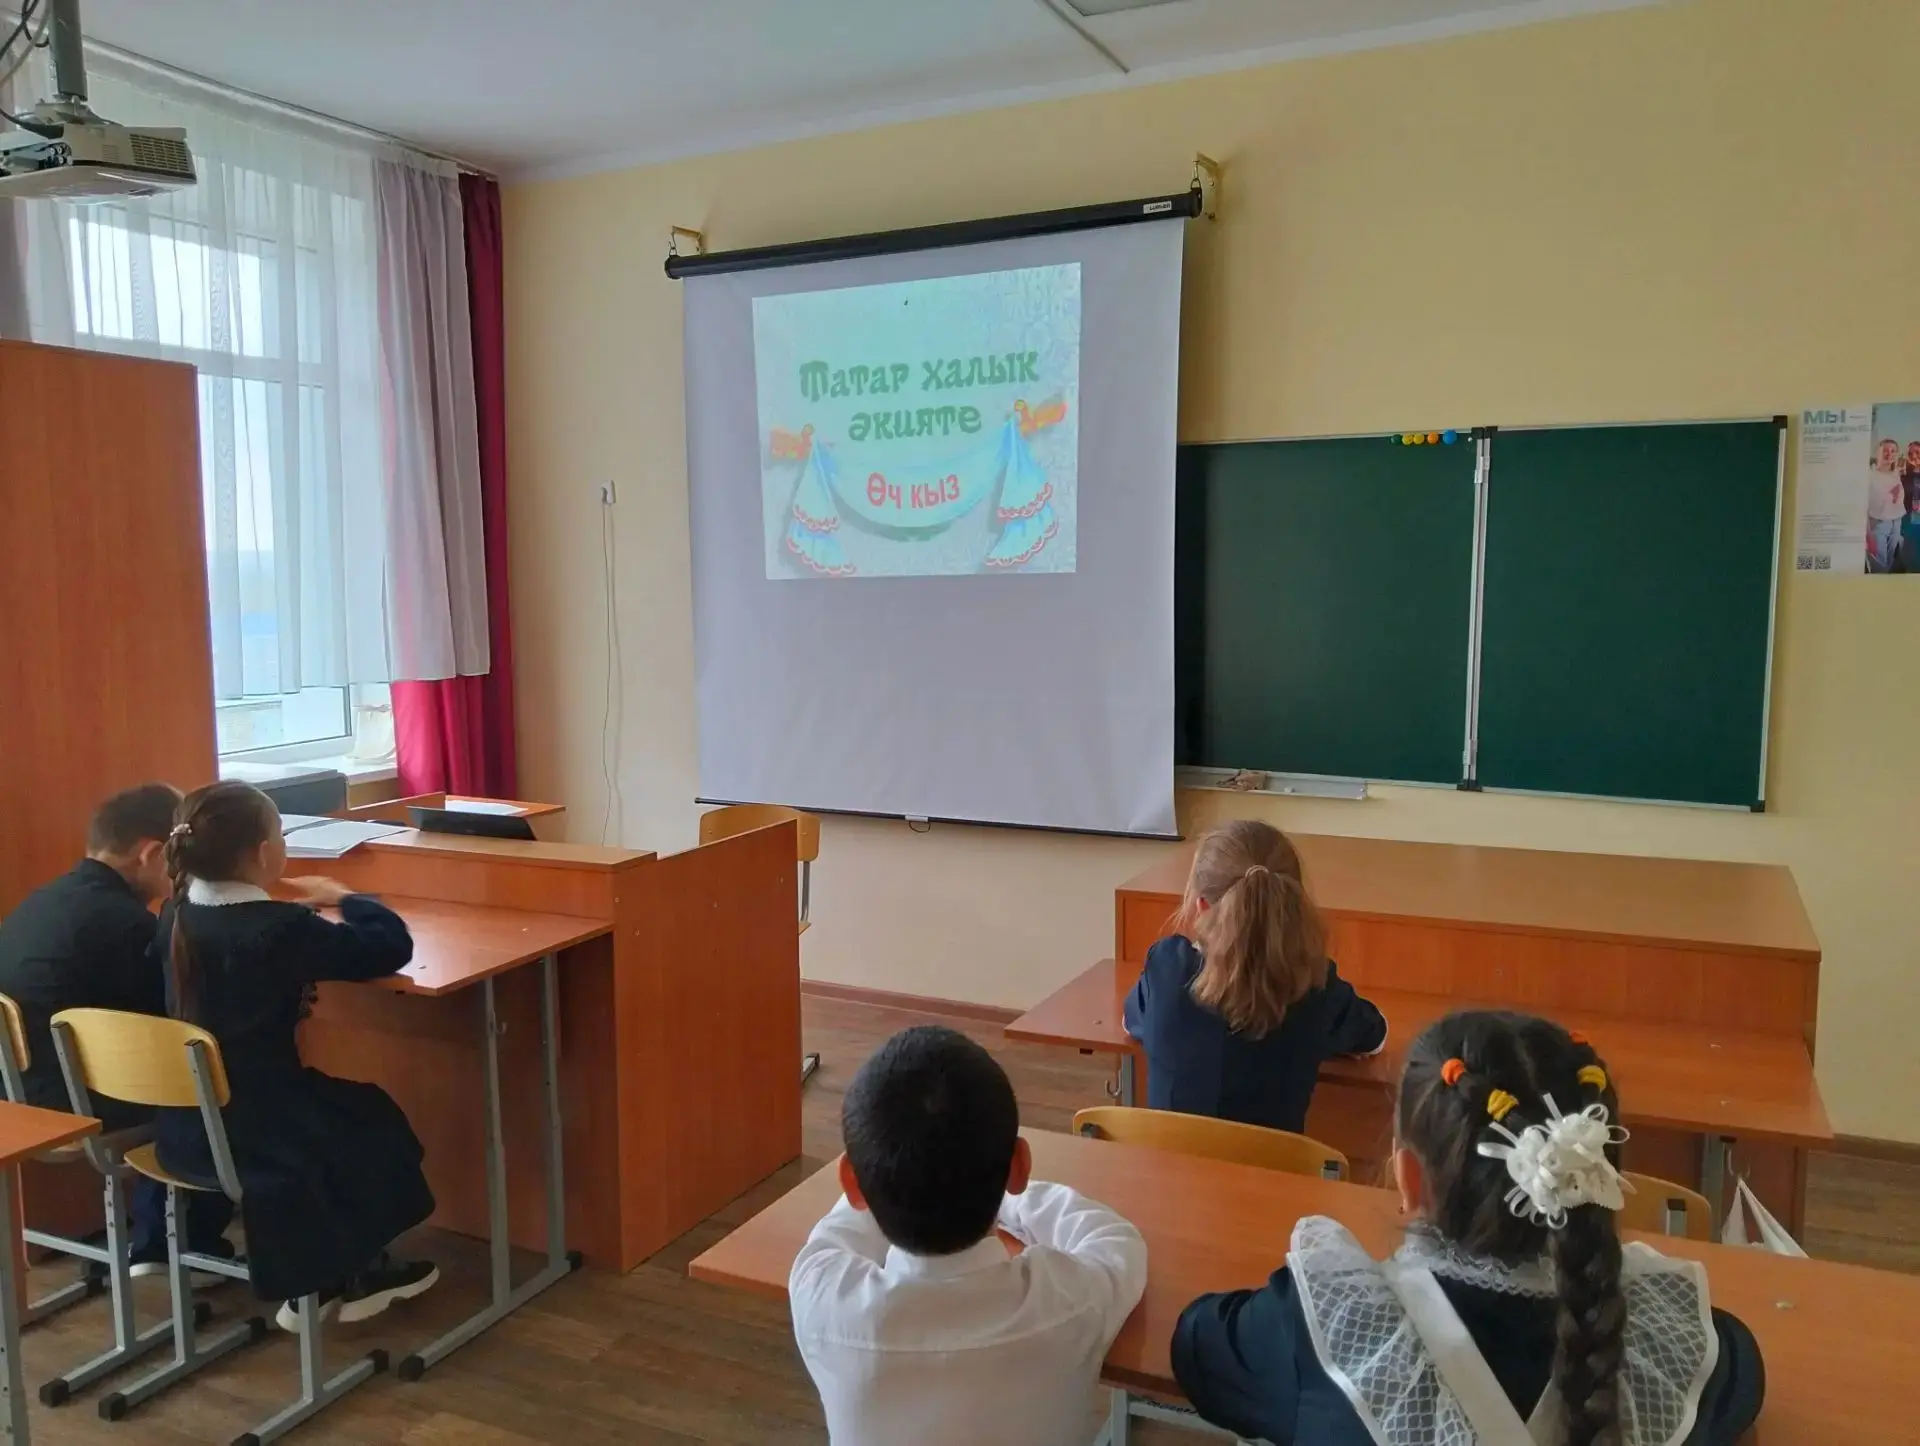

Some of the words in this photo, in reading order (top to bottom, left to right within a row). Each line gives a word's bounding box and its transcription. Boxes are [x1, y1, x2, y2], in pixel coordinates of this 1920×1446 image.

[799, 360, 910, 403] Татар
[920, 351, 1041, 392] халык
[848, 405, 983, 442] әкияте
[866, 471, 902, 510] Өч
[911, 473, 960, 509] кыз
